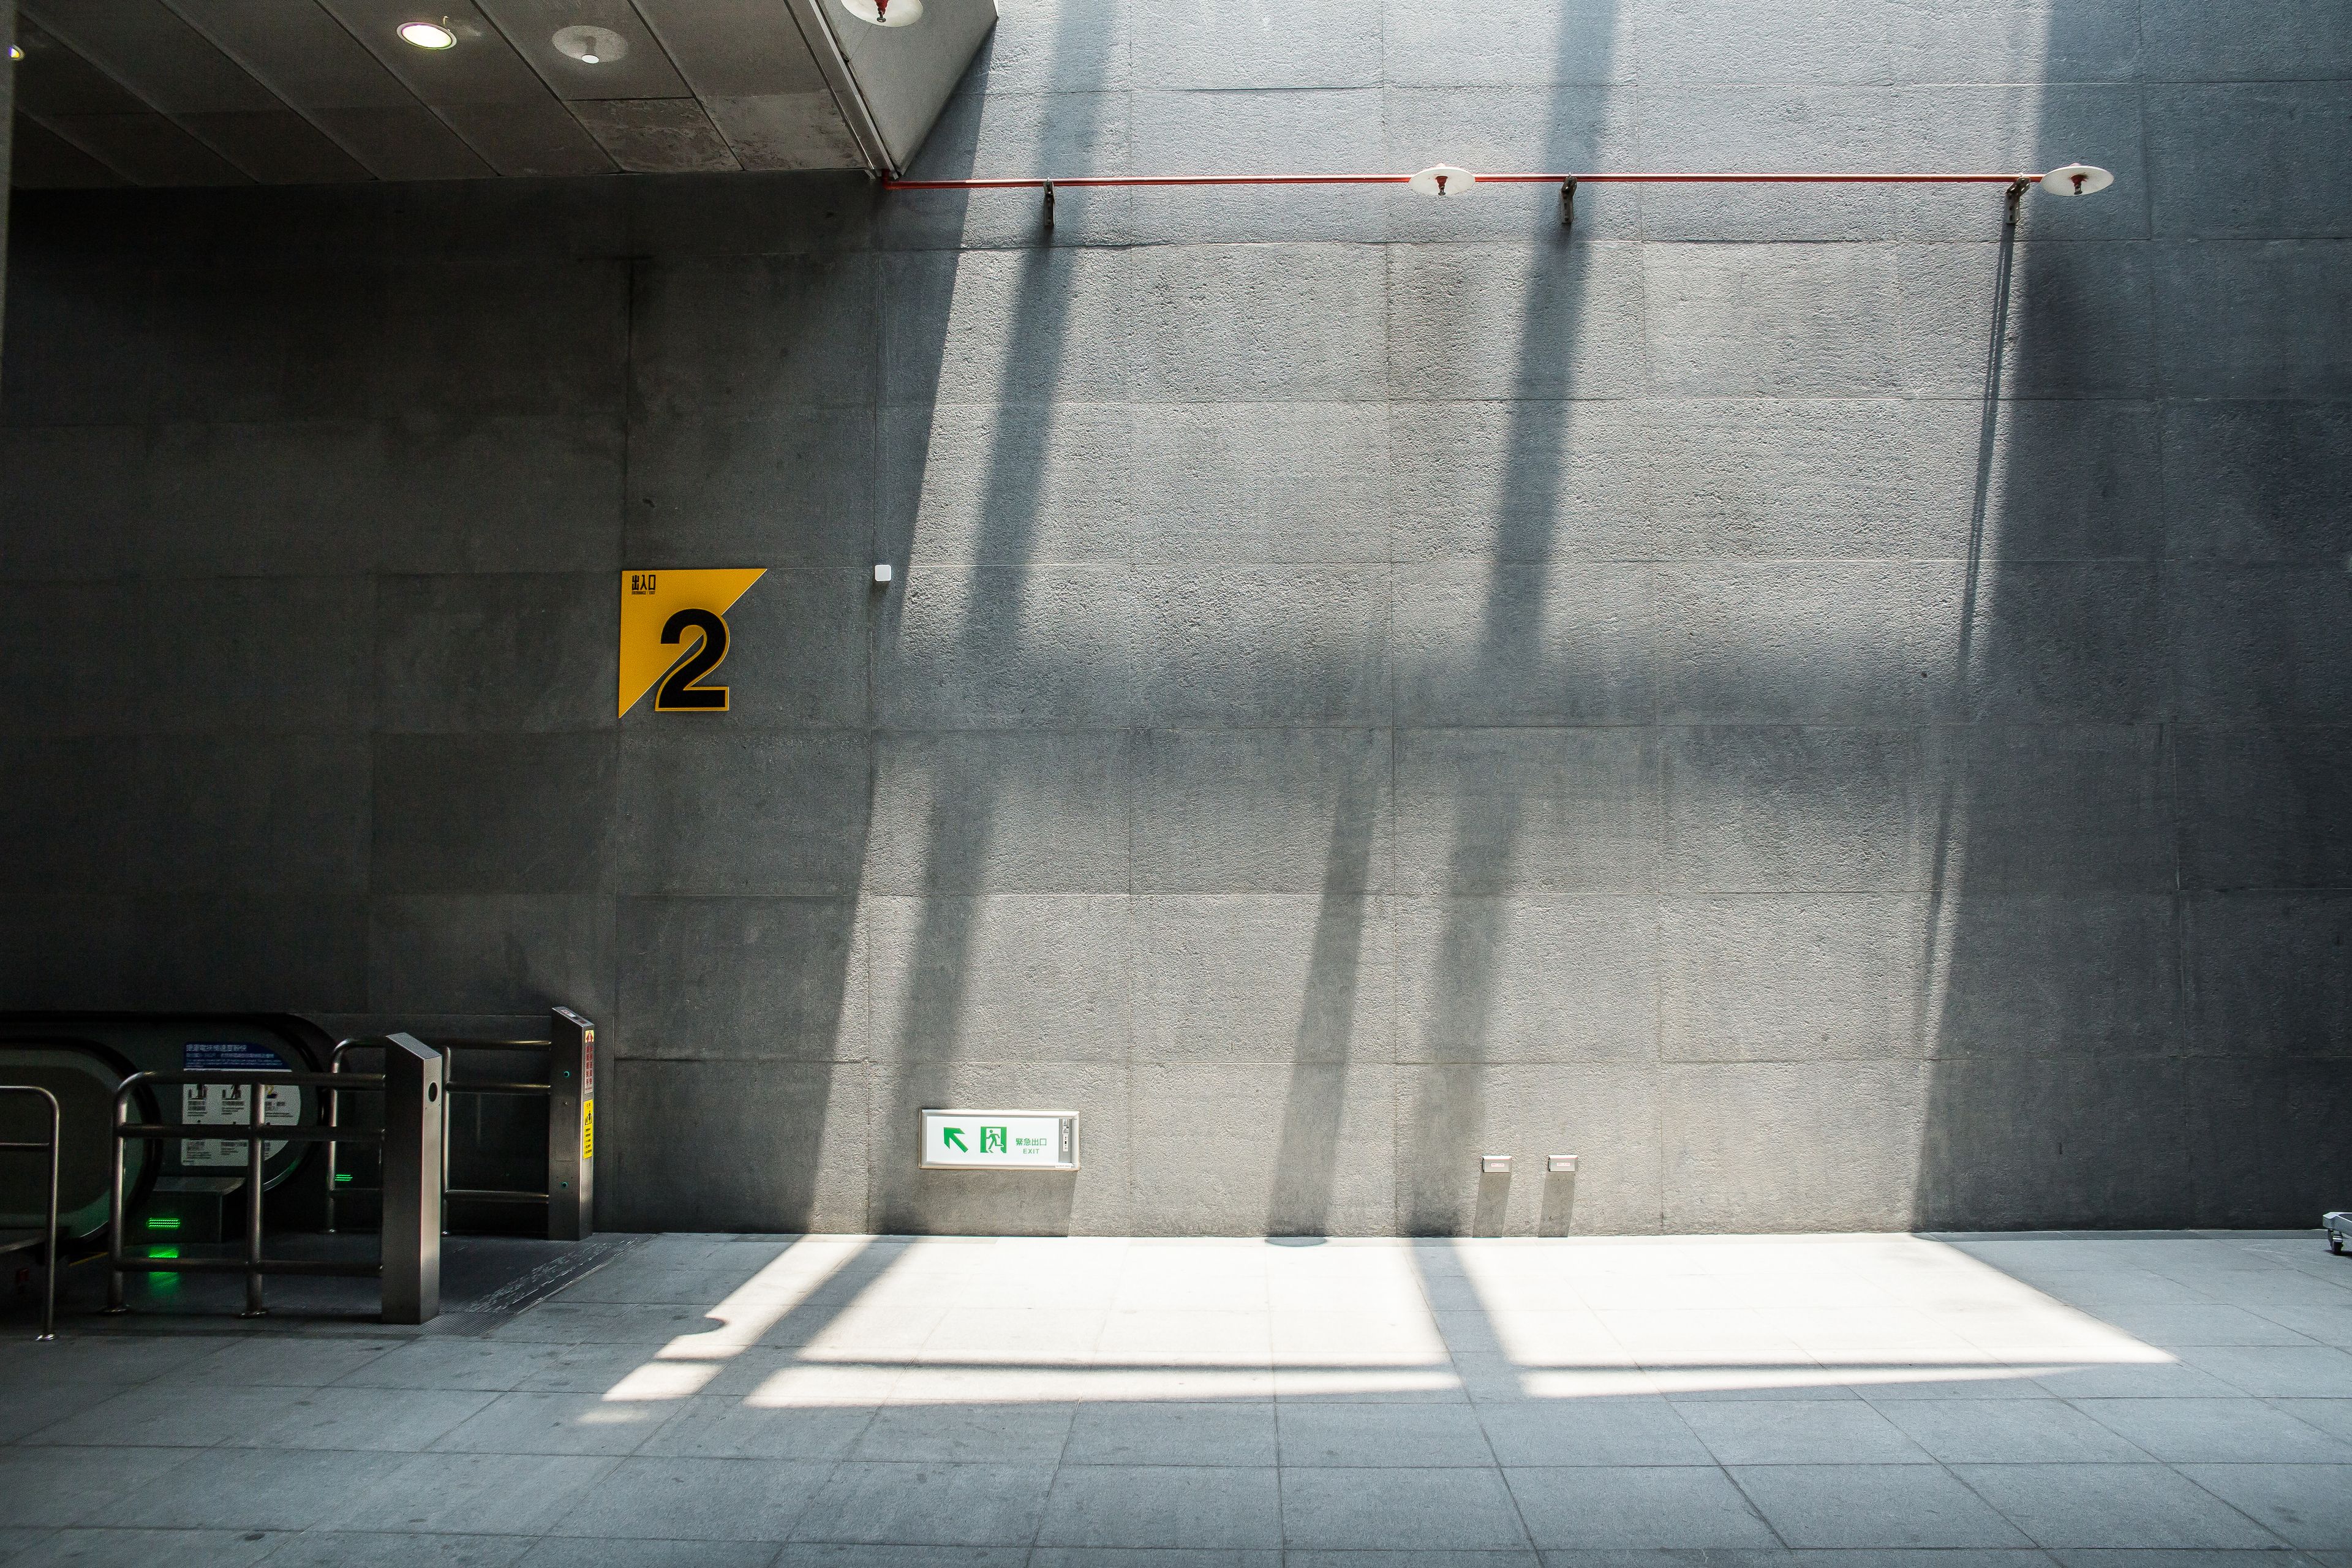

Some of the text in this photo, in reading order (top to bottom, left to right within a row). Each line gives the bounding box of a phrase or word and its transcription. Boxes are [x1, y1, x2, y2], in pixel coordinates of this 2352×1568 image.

[631, 575, 656, 590] 出入口
[655, 608, 729, 711] 2
